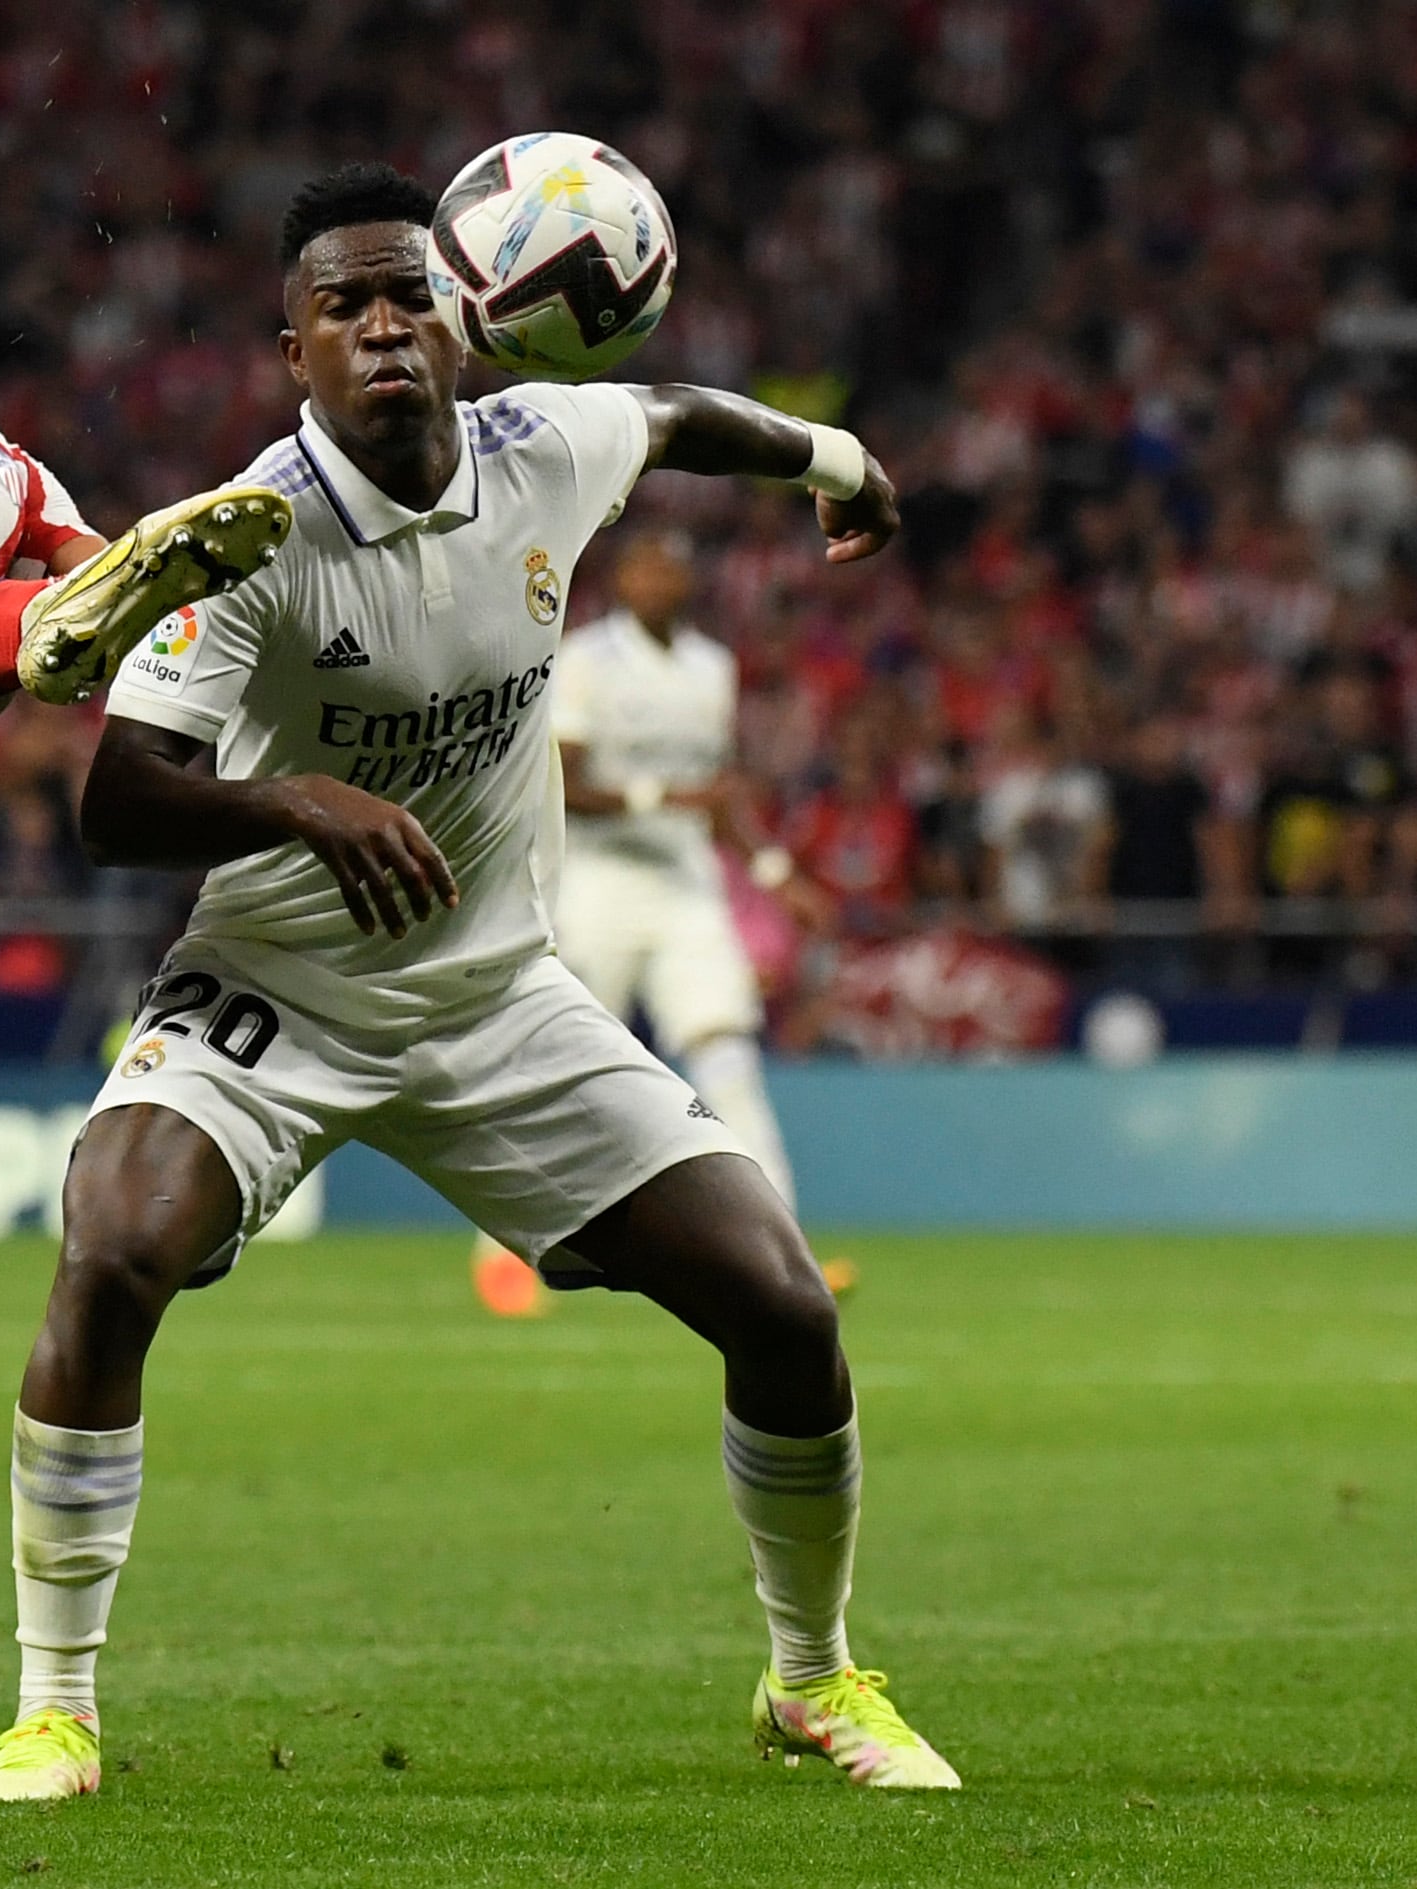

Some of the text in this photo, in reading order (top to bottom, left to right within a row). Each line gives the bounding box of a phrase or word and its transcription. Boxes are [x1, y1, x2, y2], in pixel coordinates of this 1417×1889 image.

[132, 655, 181, 683] LaLiga
[313, 653, 371, 669] adidas
[318, 654, 554, 748] Emirates
[347, 720, 518, 791] FLY BETTER
[133, 971, 280, 1070] 20
